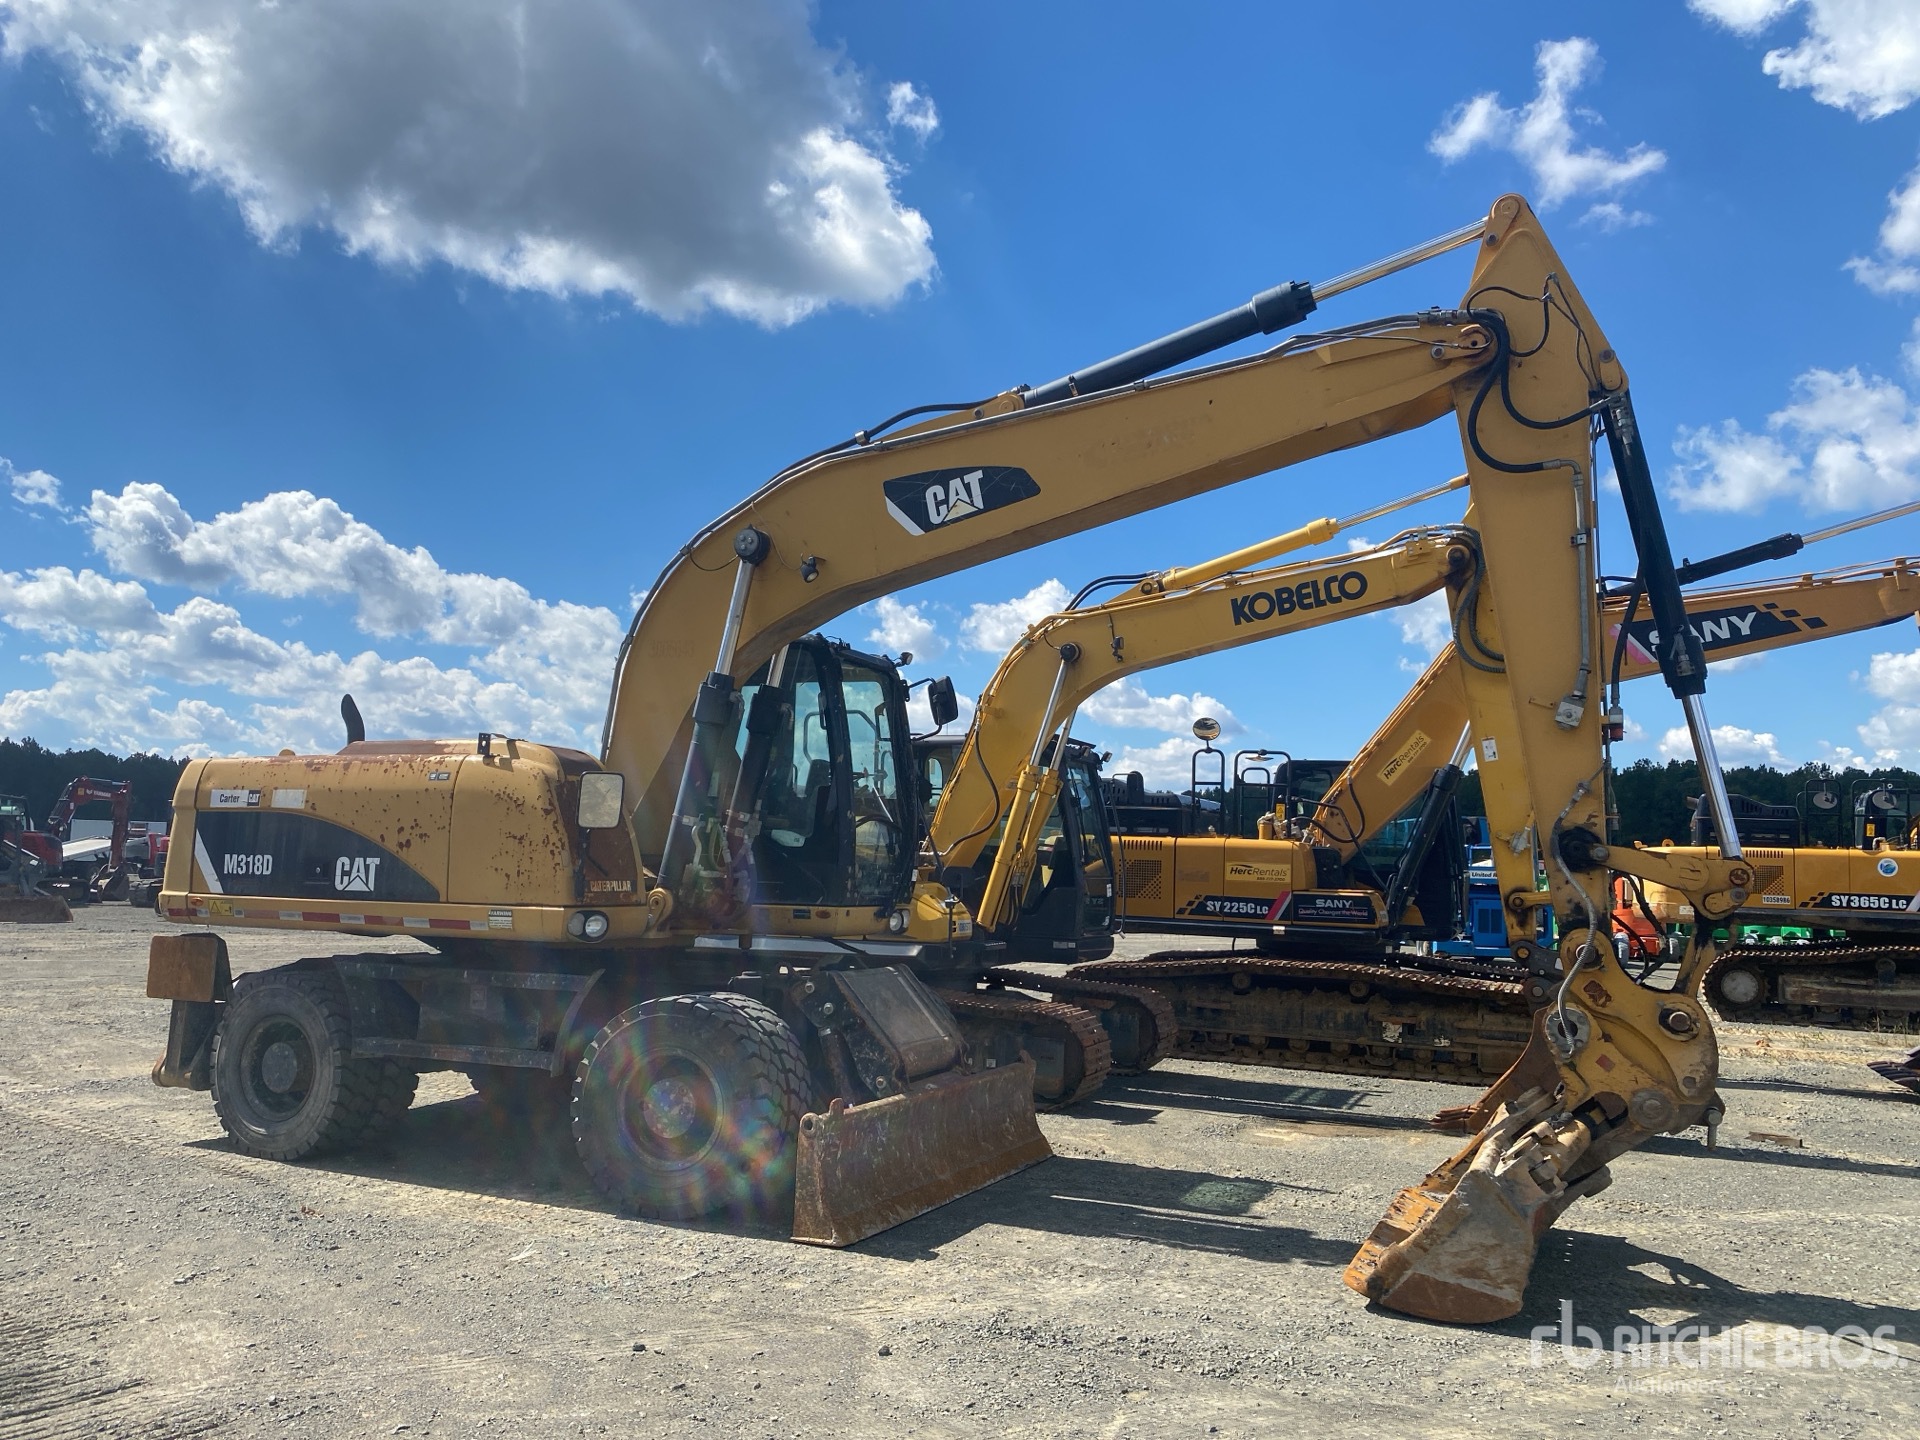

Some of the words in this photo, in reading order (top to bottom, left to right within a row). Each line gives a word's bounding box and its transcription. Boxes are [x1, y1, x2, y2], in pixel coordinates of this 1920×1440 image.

[925, 470, 984, 524] CAT
[1230, 571, 1368, 626] KOBELCO
[219, 793, 240, 803] Carter
[223, 853, 273, 875] M318D
[334, 856, 381, 891] CAT
[590, 880, 632, 892] CATERPILLAR
[1256, 905, 1269, 914] LC
[1315, 899, 1352, 908] SANY
[1891, 899, 1907, 909] LC
